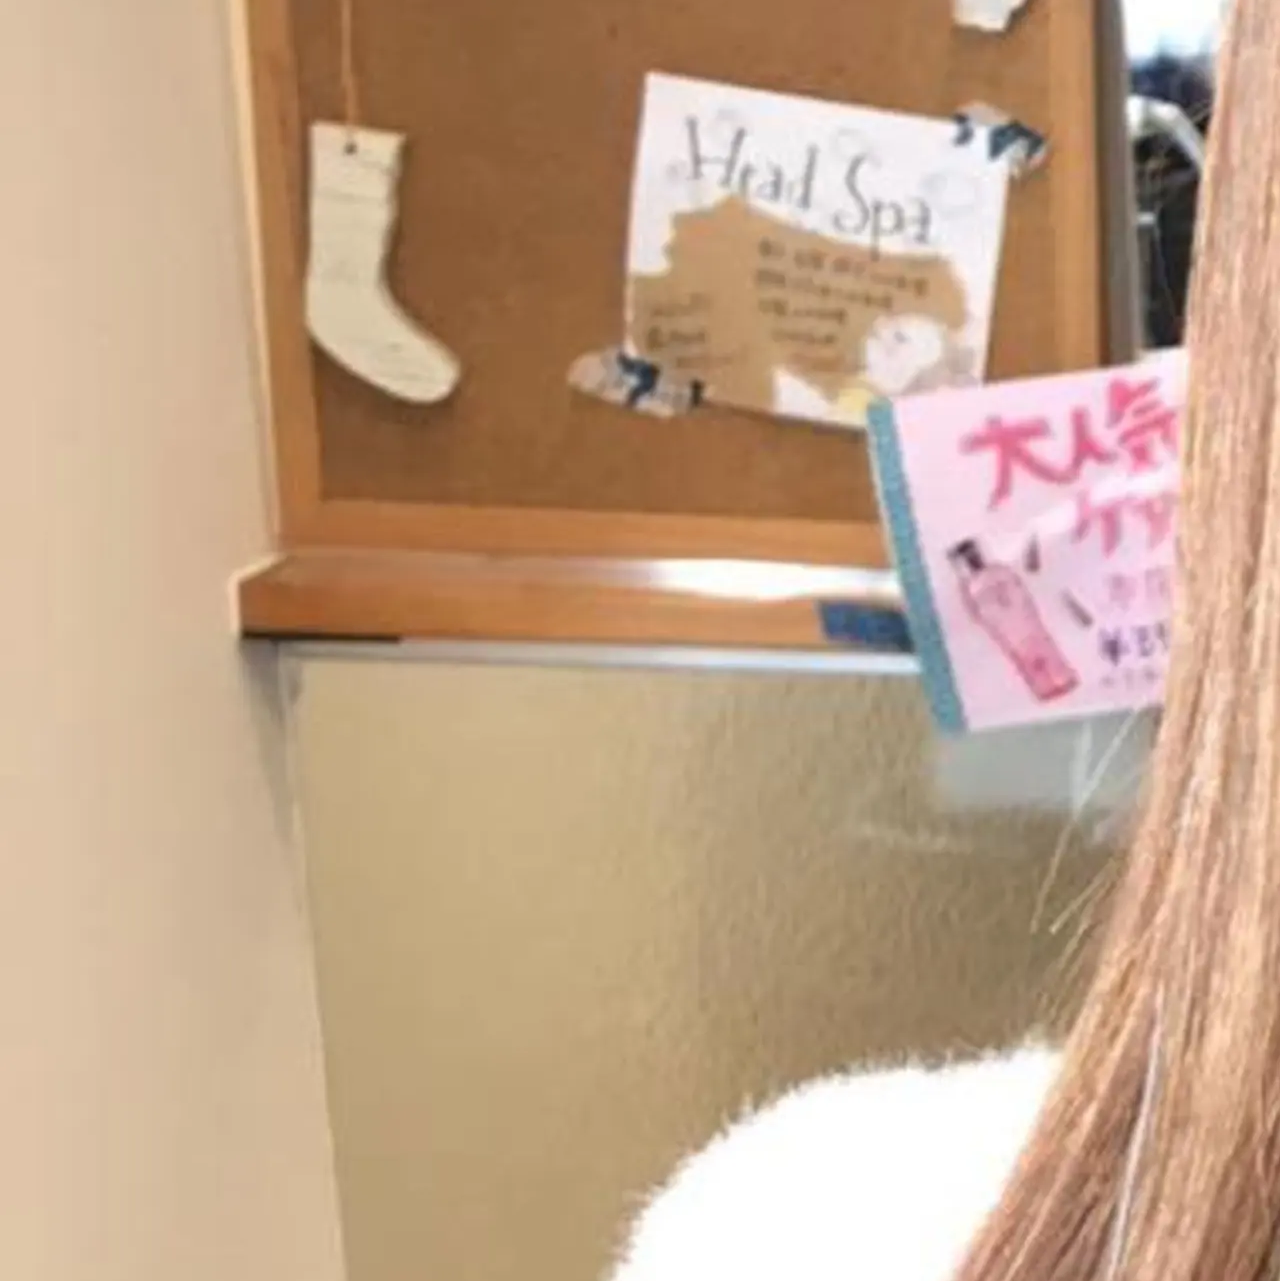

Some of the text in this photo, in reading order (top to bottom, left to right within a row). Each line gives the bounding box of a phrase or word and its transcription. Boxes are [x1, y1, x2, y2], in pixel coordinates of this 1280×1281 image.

[686, 115, 933, 262] Head Spa
[960, 375, 1178, 511] 大人気
